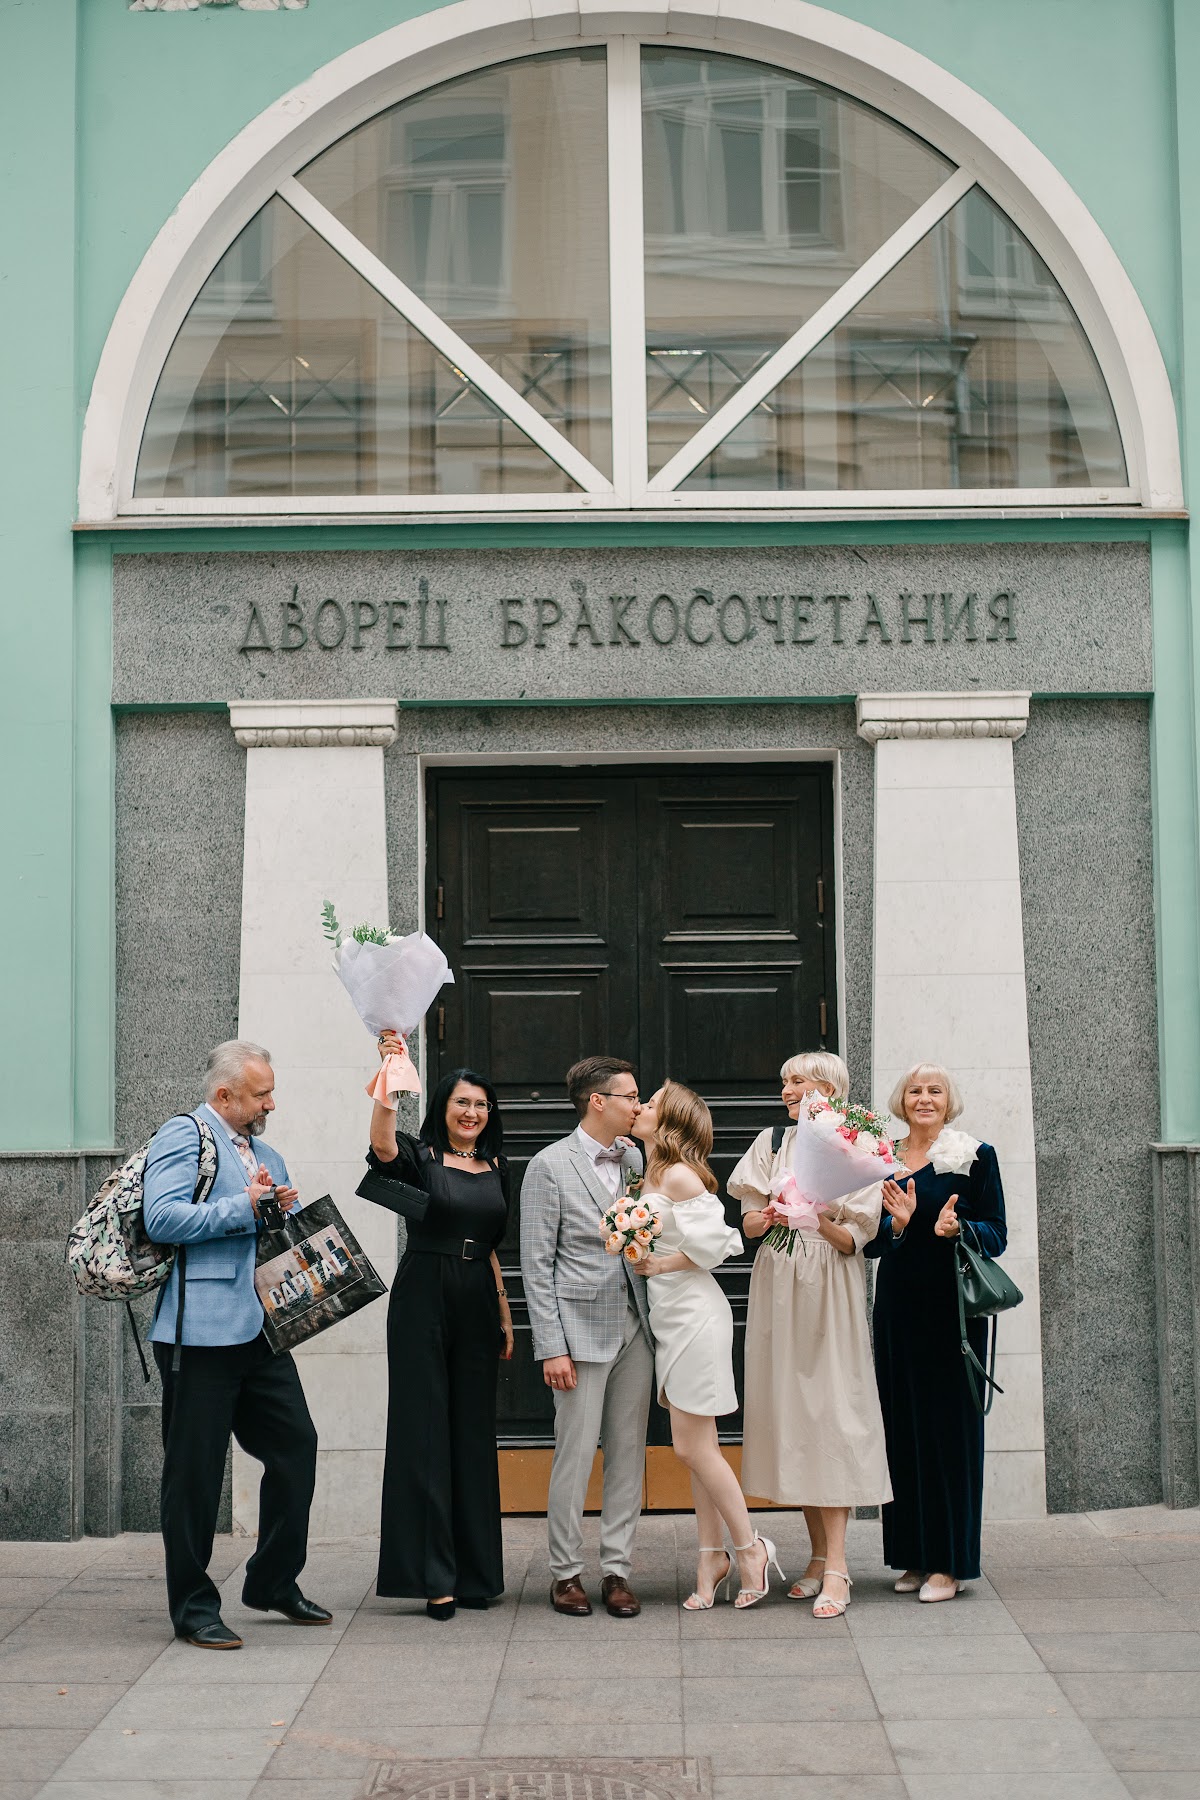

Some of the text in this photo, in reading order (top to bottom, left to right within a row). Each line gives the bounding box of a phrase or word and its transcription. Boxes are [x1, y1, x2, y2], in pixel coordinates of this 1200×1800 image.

[238, 590, 1018, 656] ДВОРЕЦ БРАКОСОЧЕТАНИЯ
[268, 1251, 349, 1309] CAPITAL
